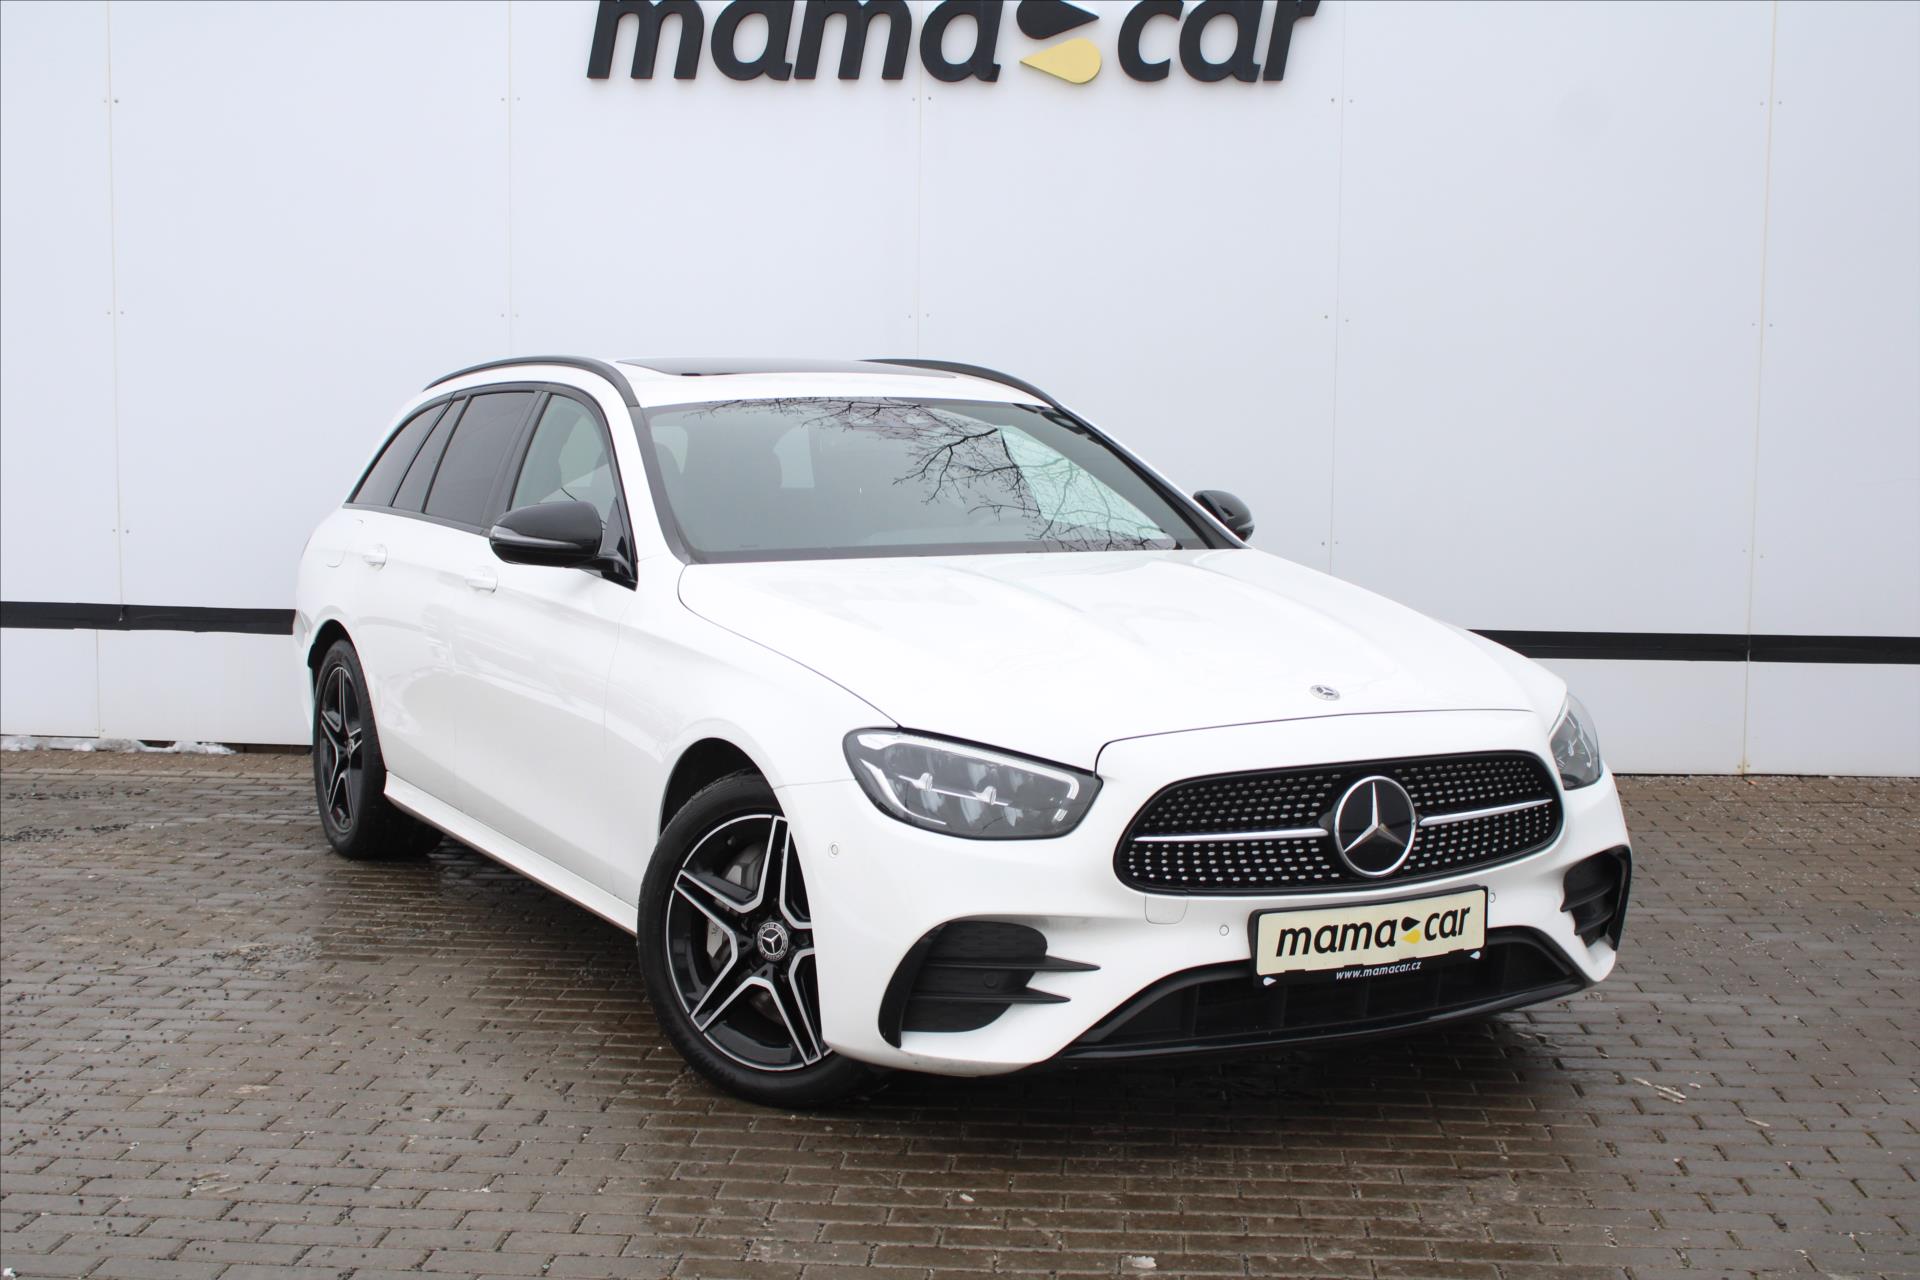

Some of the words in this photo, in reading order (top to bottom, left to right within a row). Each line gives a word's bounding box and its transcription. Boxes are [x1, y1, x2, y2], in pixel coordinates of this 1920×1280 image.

[586, 0, 1004, 82] mama
[1117, 0, 1323, 84] car
[1275, 918, 1398, 957] mama
[1424, 906, 1471, 941] car
[1336, 961, 1422, 980] www.mamacar.cz
